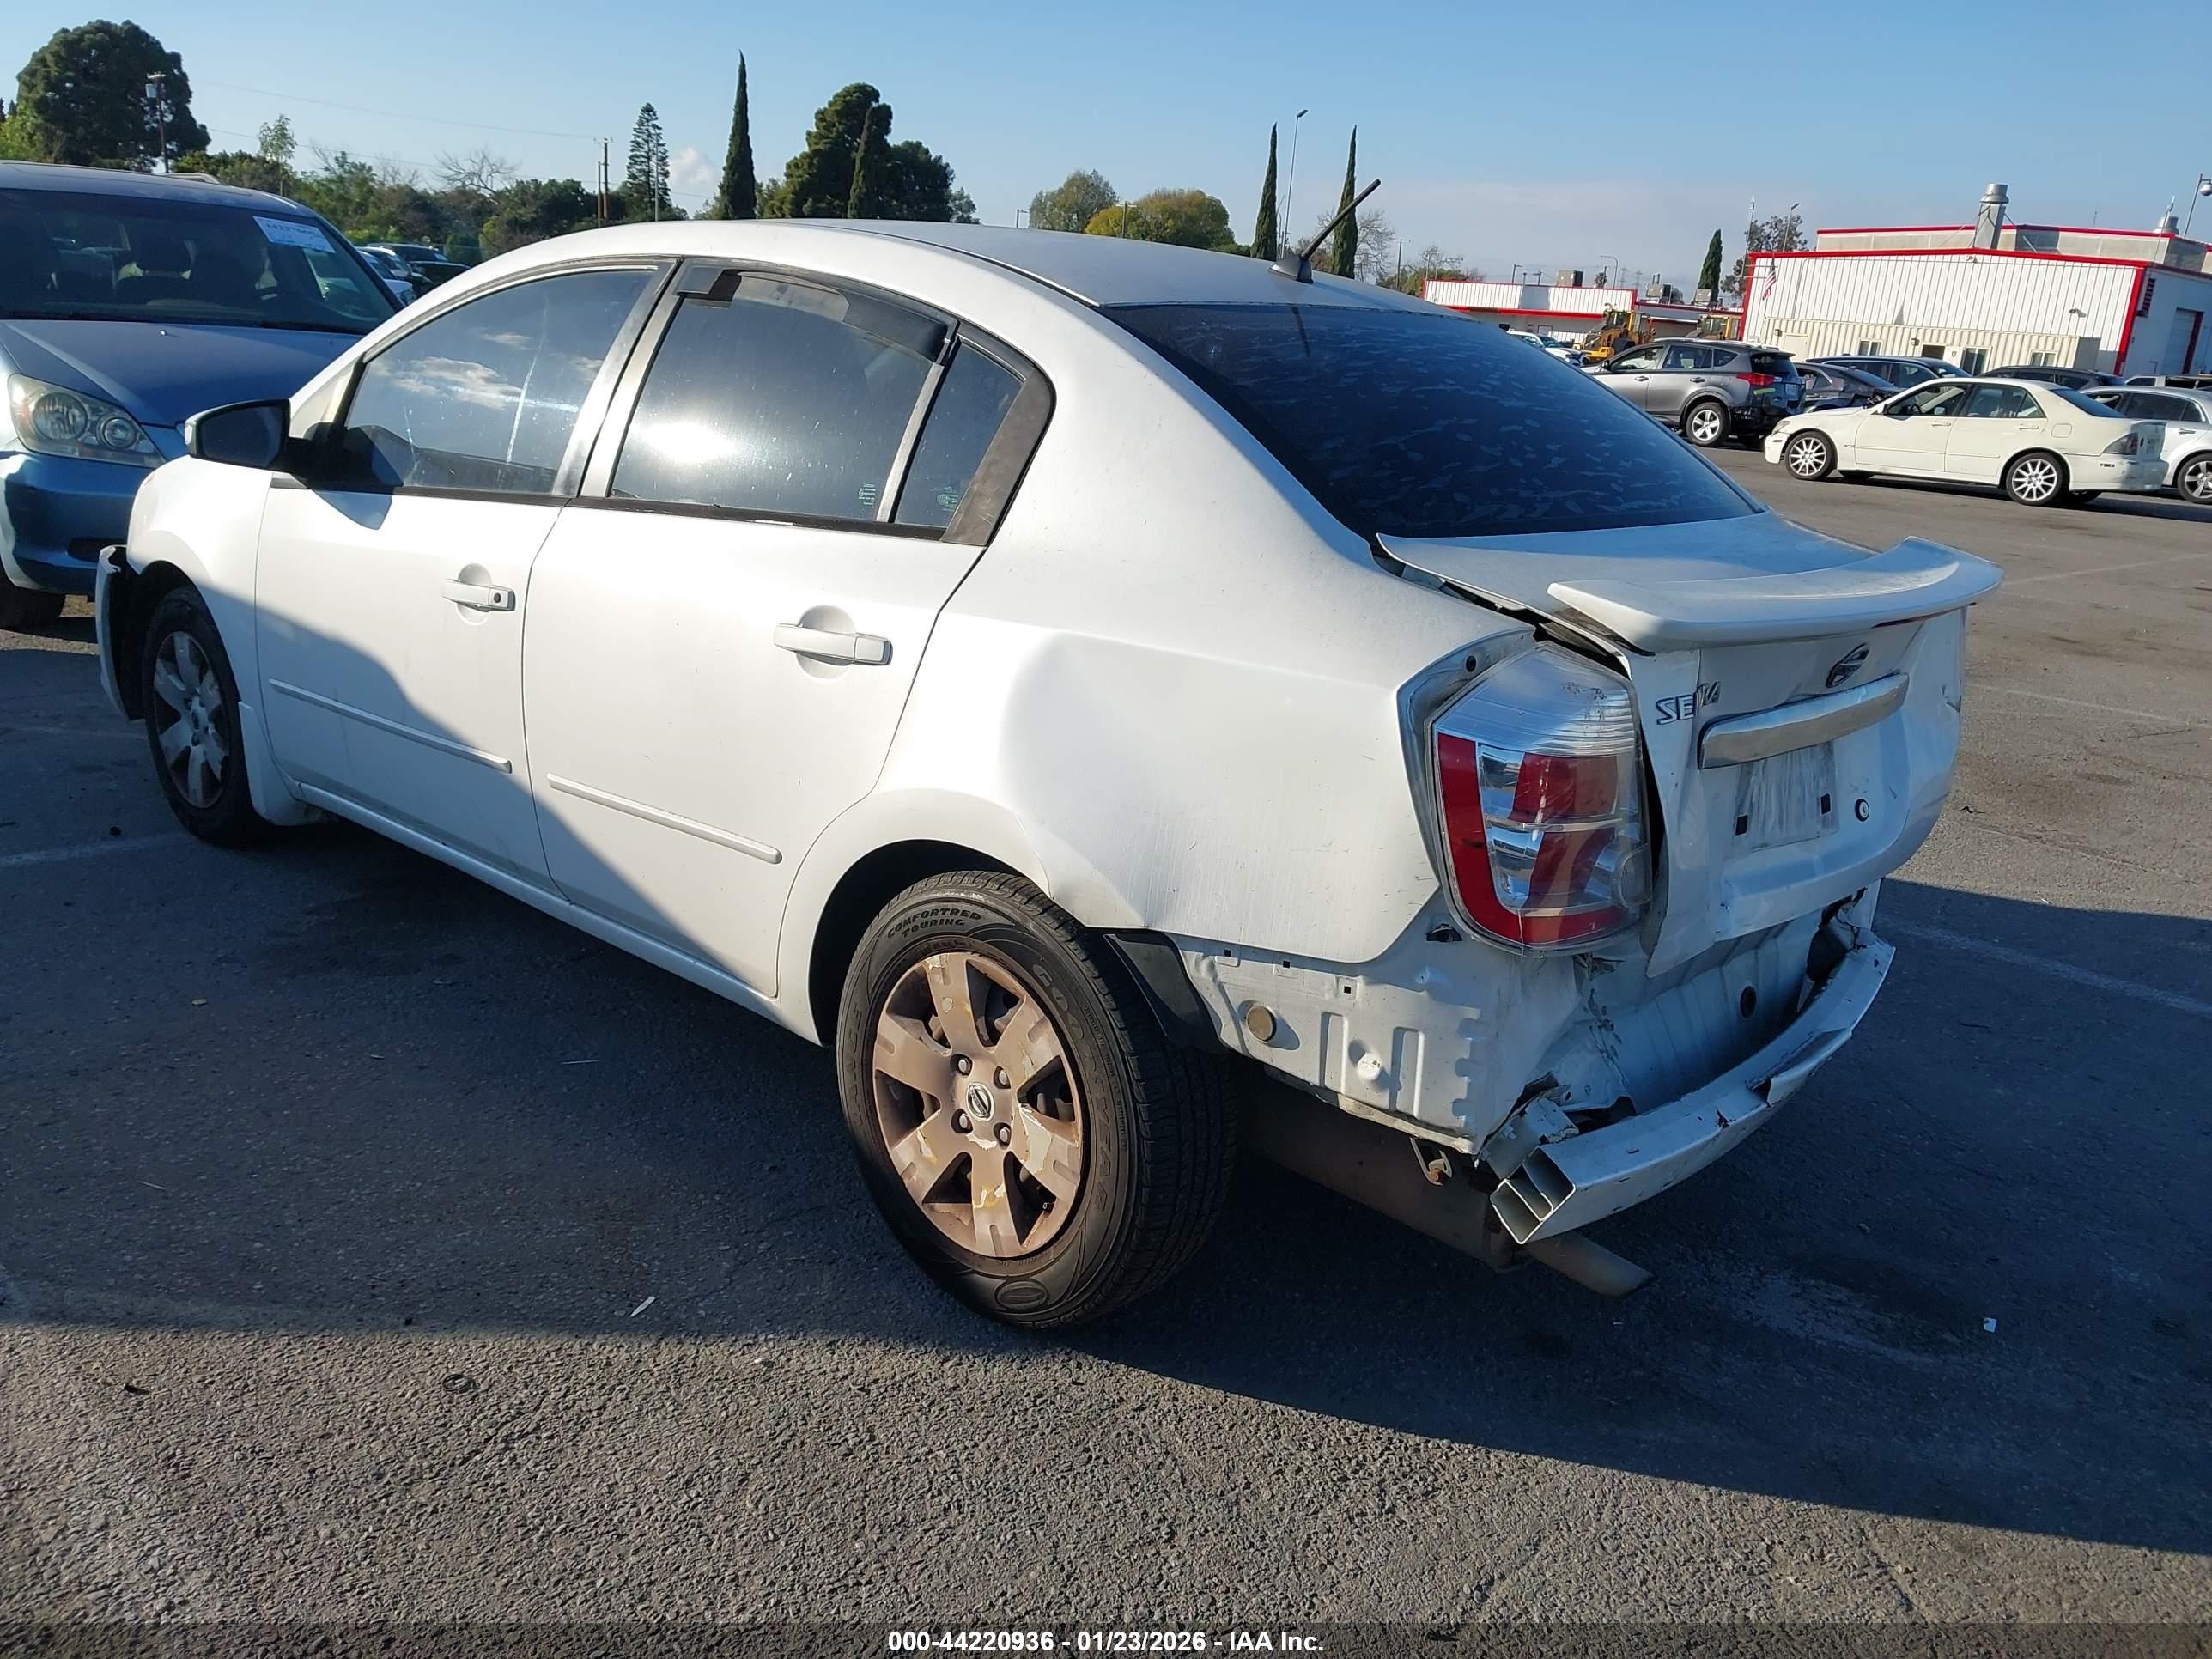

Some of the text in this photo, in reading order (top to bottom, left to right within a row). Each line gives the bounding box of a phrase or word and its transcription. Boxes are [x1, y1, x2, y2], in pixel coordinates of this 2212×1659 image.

[1656, 680, 1720, 725] SEA
[888, 908, 981, 938] COMFORTRED
[902, 918, 965, 938] TOURING
